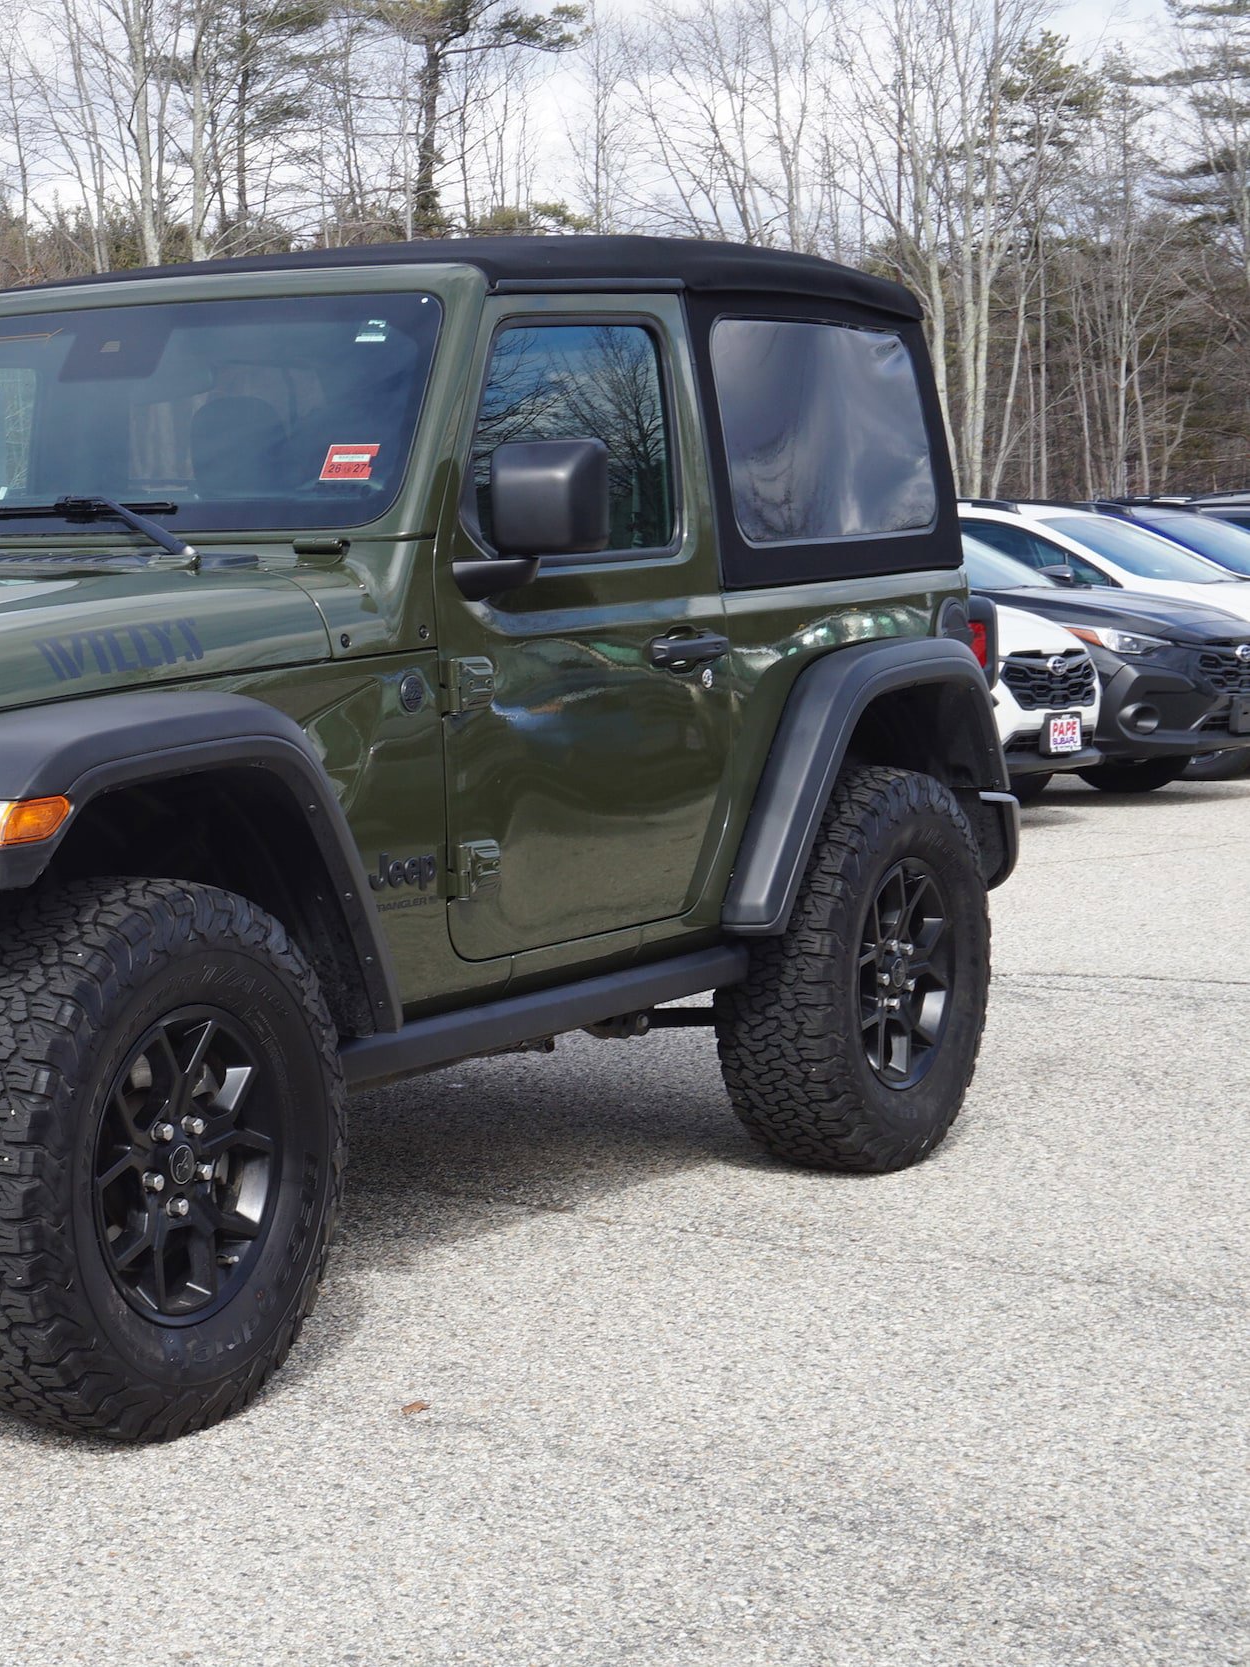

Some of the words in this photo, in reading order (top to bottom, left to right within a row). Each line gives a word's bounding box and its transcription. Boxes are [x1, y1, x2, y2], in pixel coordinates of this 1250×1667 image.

[353, 463, 367, 473] 27
[33, 617, 204, 681] WILLYS
[1053, 721, 1077, 736] PAPE
[368, 852, 436, 891] Jeep
[376, 897, 427, 912] RANGLER
